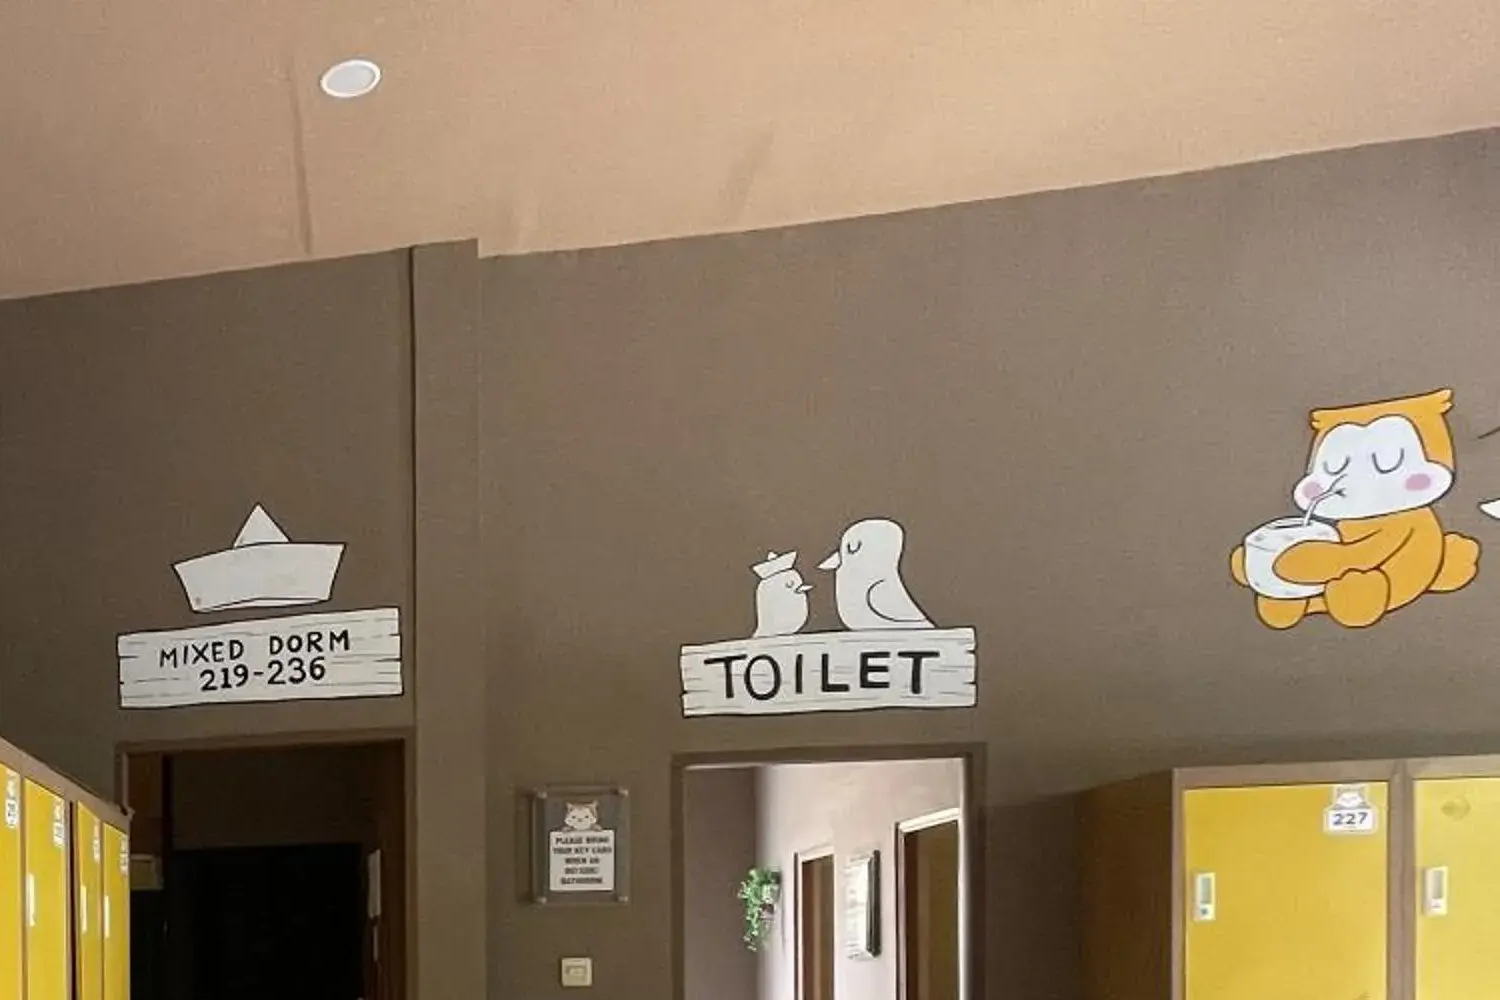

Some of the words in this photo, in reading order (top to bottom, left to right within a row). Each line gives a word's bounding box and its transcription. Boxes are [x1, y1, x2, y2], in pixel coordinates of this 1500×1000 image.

[159, 638, 245, 668] MIXED
[269, 629, 351, 655] DORM
[200, 656, 327, 692] 219-236
[703, 651, 940, 700] TOILET
[1332, 811, 1368, 826] 227
